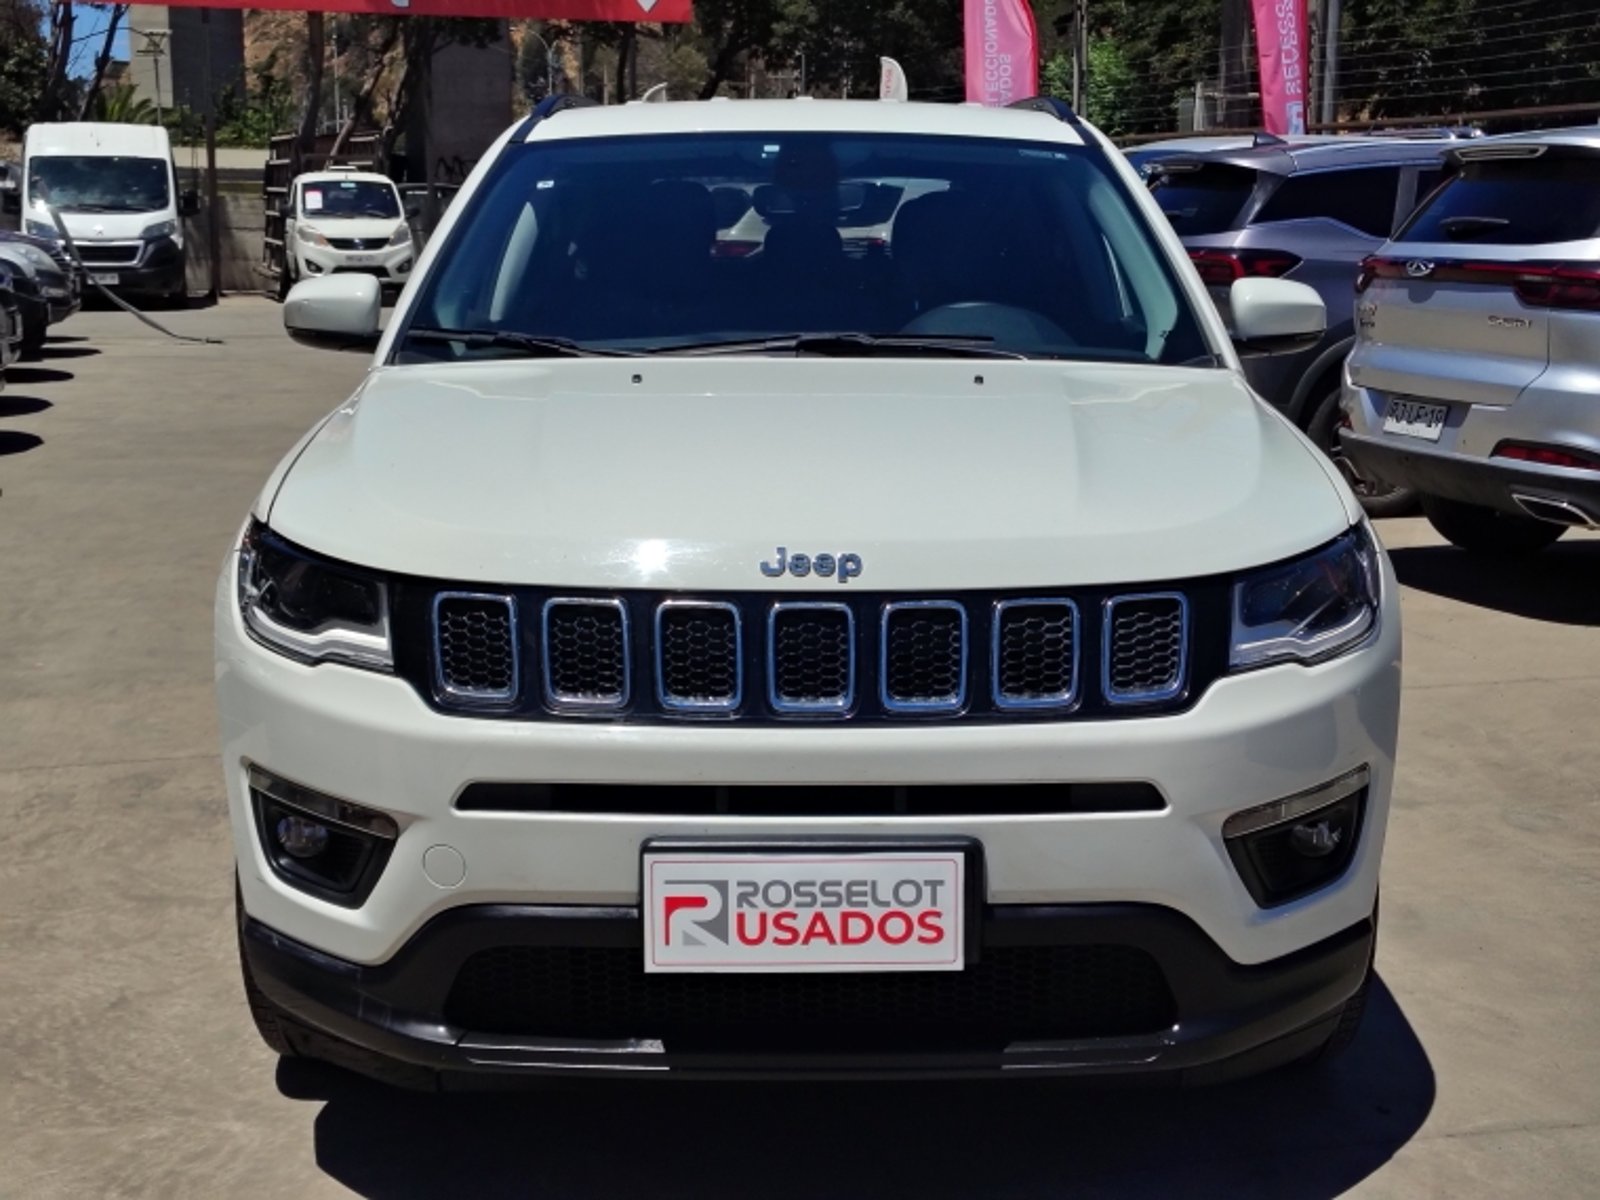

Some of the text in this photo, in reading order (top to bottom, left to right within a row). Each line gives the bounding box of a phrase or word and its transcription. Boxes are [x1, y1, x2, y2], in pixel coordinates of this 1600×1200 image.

[760, 547, 863, 583] Jeep
[736, 879, 944, 908] ROSSELOT
[736, 910, 944, 947] USADOS
